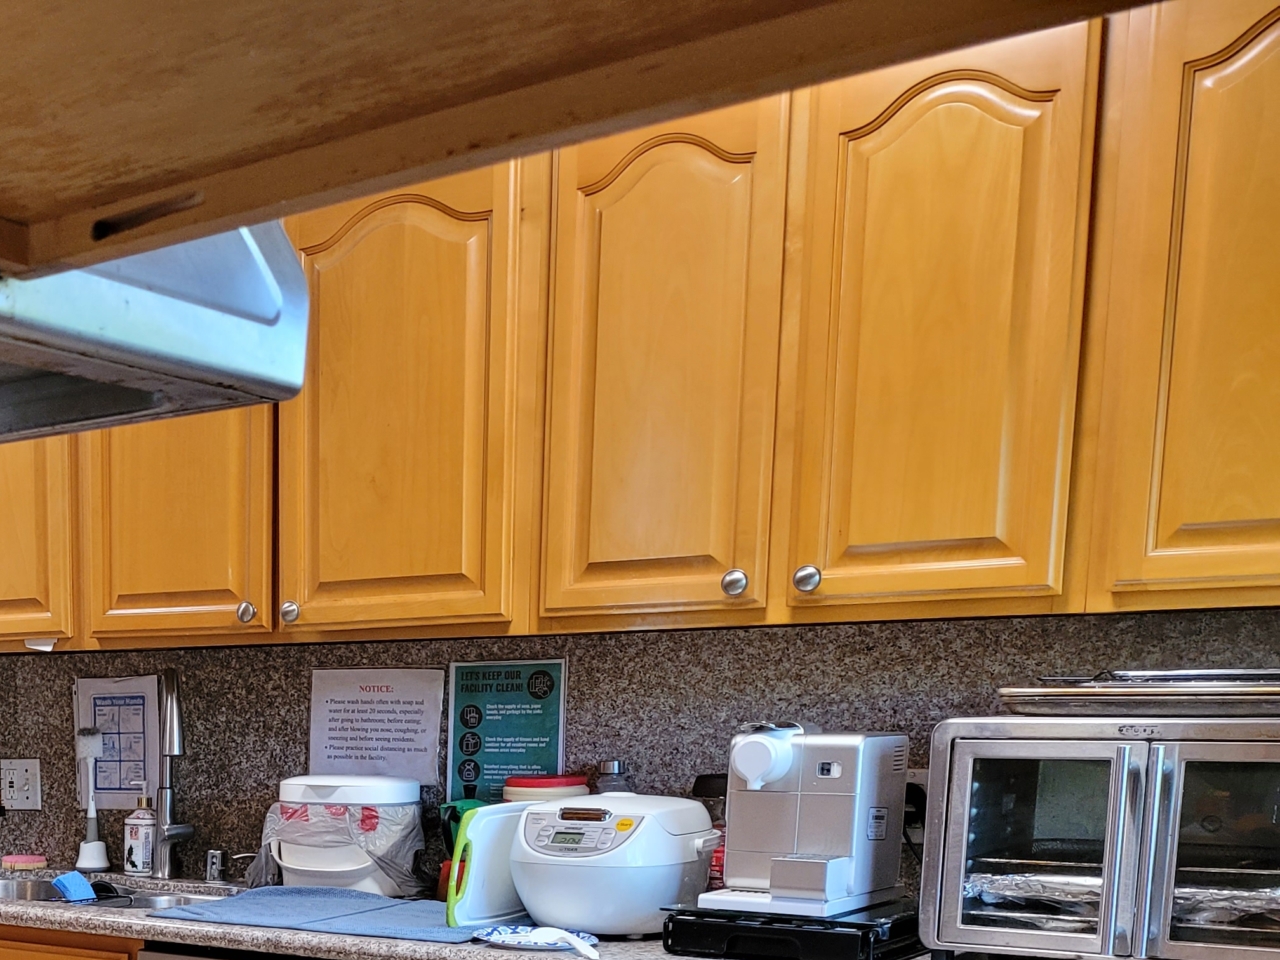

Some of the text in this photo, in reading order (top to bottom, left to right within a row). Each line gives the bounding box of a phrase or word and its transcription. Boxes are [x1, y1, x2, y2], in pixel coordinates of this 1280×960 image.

[461, 671, 521, 681] LET'S KEEP OUR
[359, 685, 394, 693] NOTICE:
[461, 683, 523, 693] FACILITY CLEAN!
[402, 700, 414, 708] soap
[377, 709, 399, 717] seconds,
[399, 709, 425, 717] especially
[350, 726, 369, 735] blowing
[345, 745, 364, 753] practice
[380, 746, 407, 754] distancing
